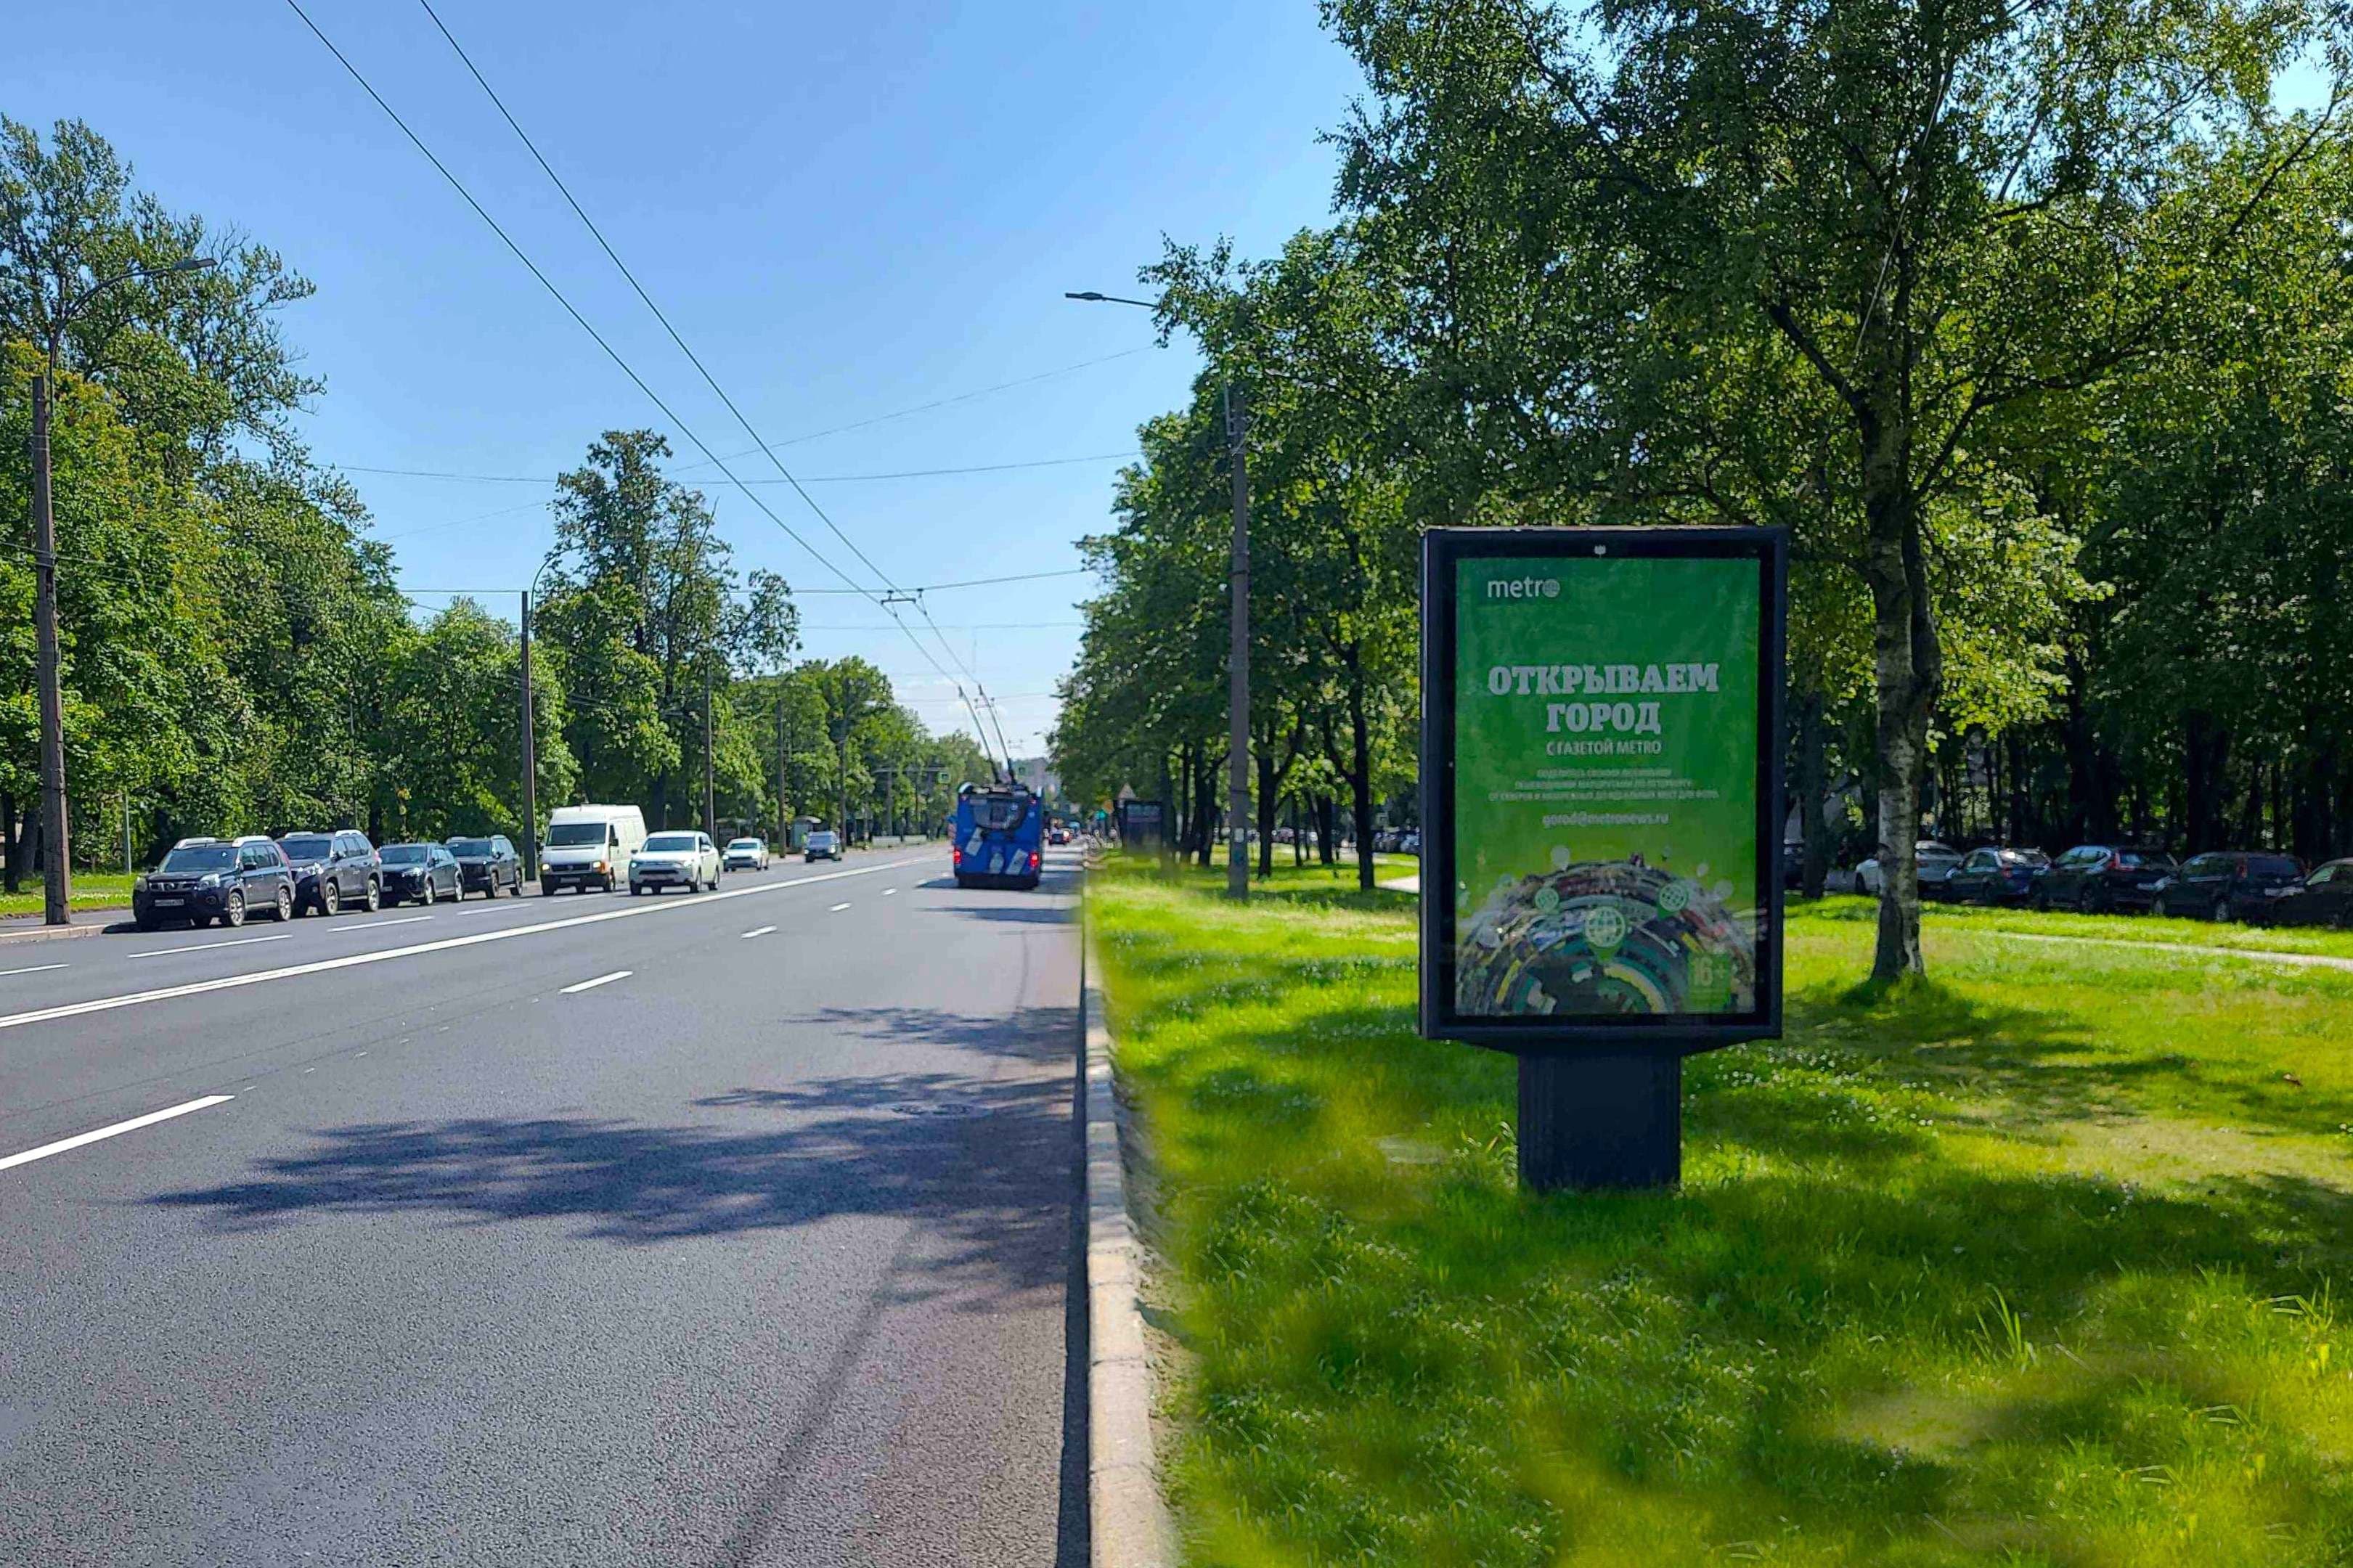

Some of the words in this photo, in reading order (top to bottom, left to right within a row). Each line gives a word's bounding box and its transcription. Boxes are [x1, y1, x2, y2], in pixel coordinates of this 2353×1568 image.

[1487, 576, 1561, 598] metro
[1488, 663, 1719, 695] ОТКРЫВАЕМ
[1546, 702, 1662, 735] ГОРОД
[1546, 741, 1556, 756] С
[1557, 738, 1613, 756] ГАЗЕТОЙ
